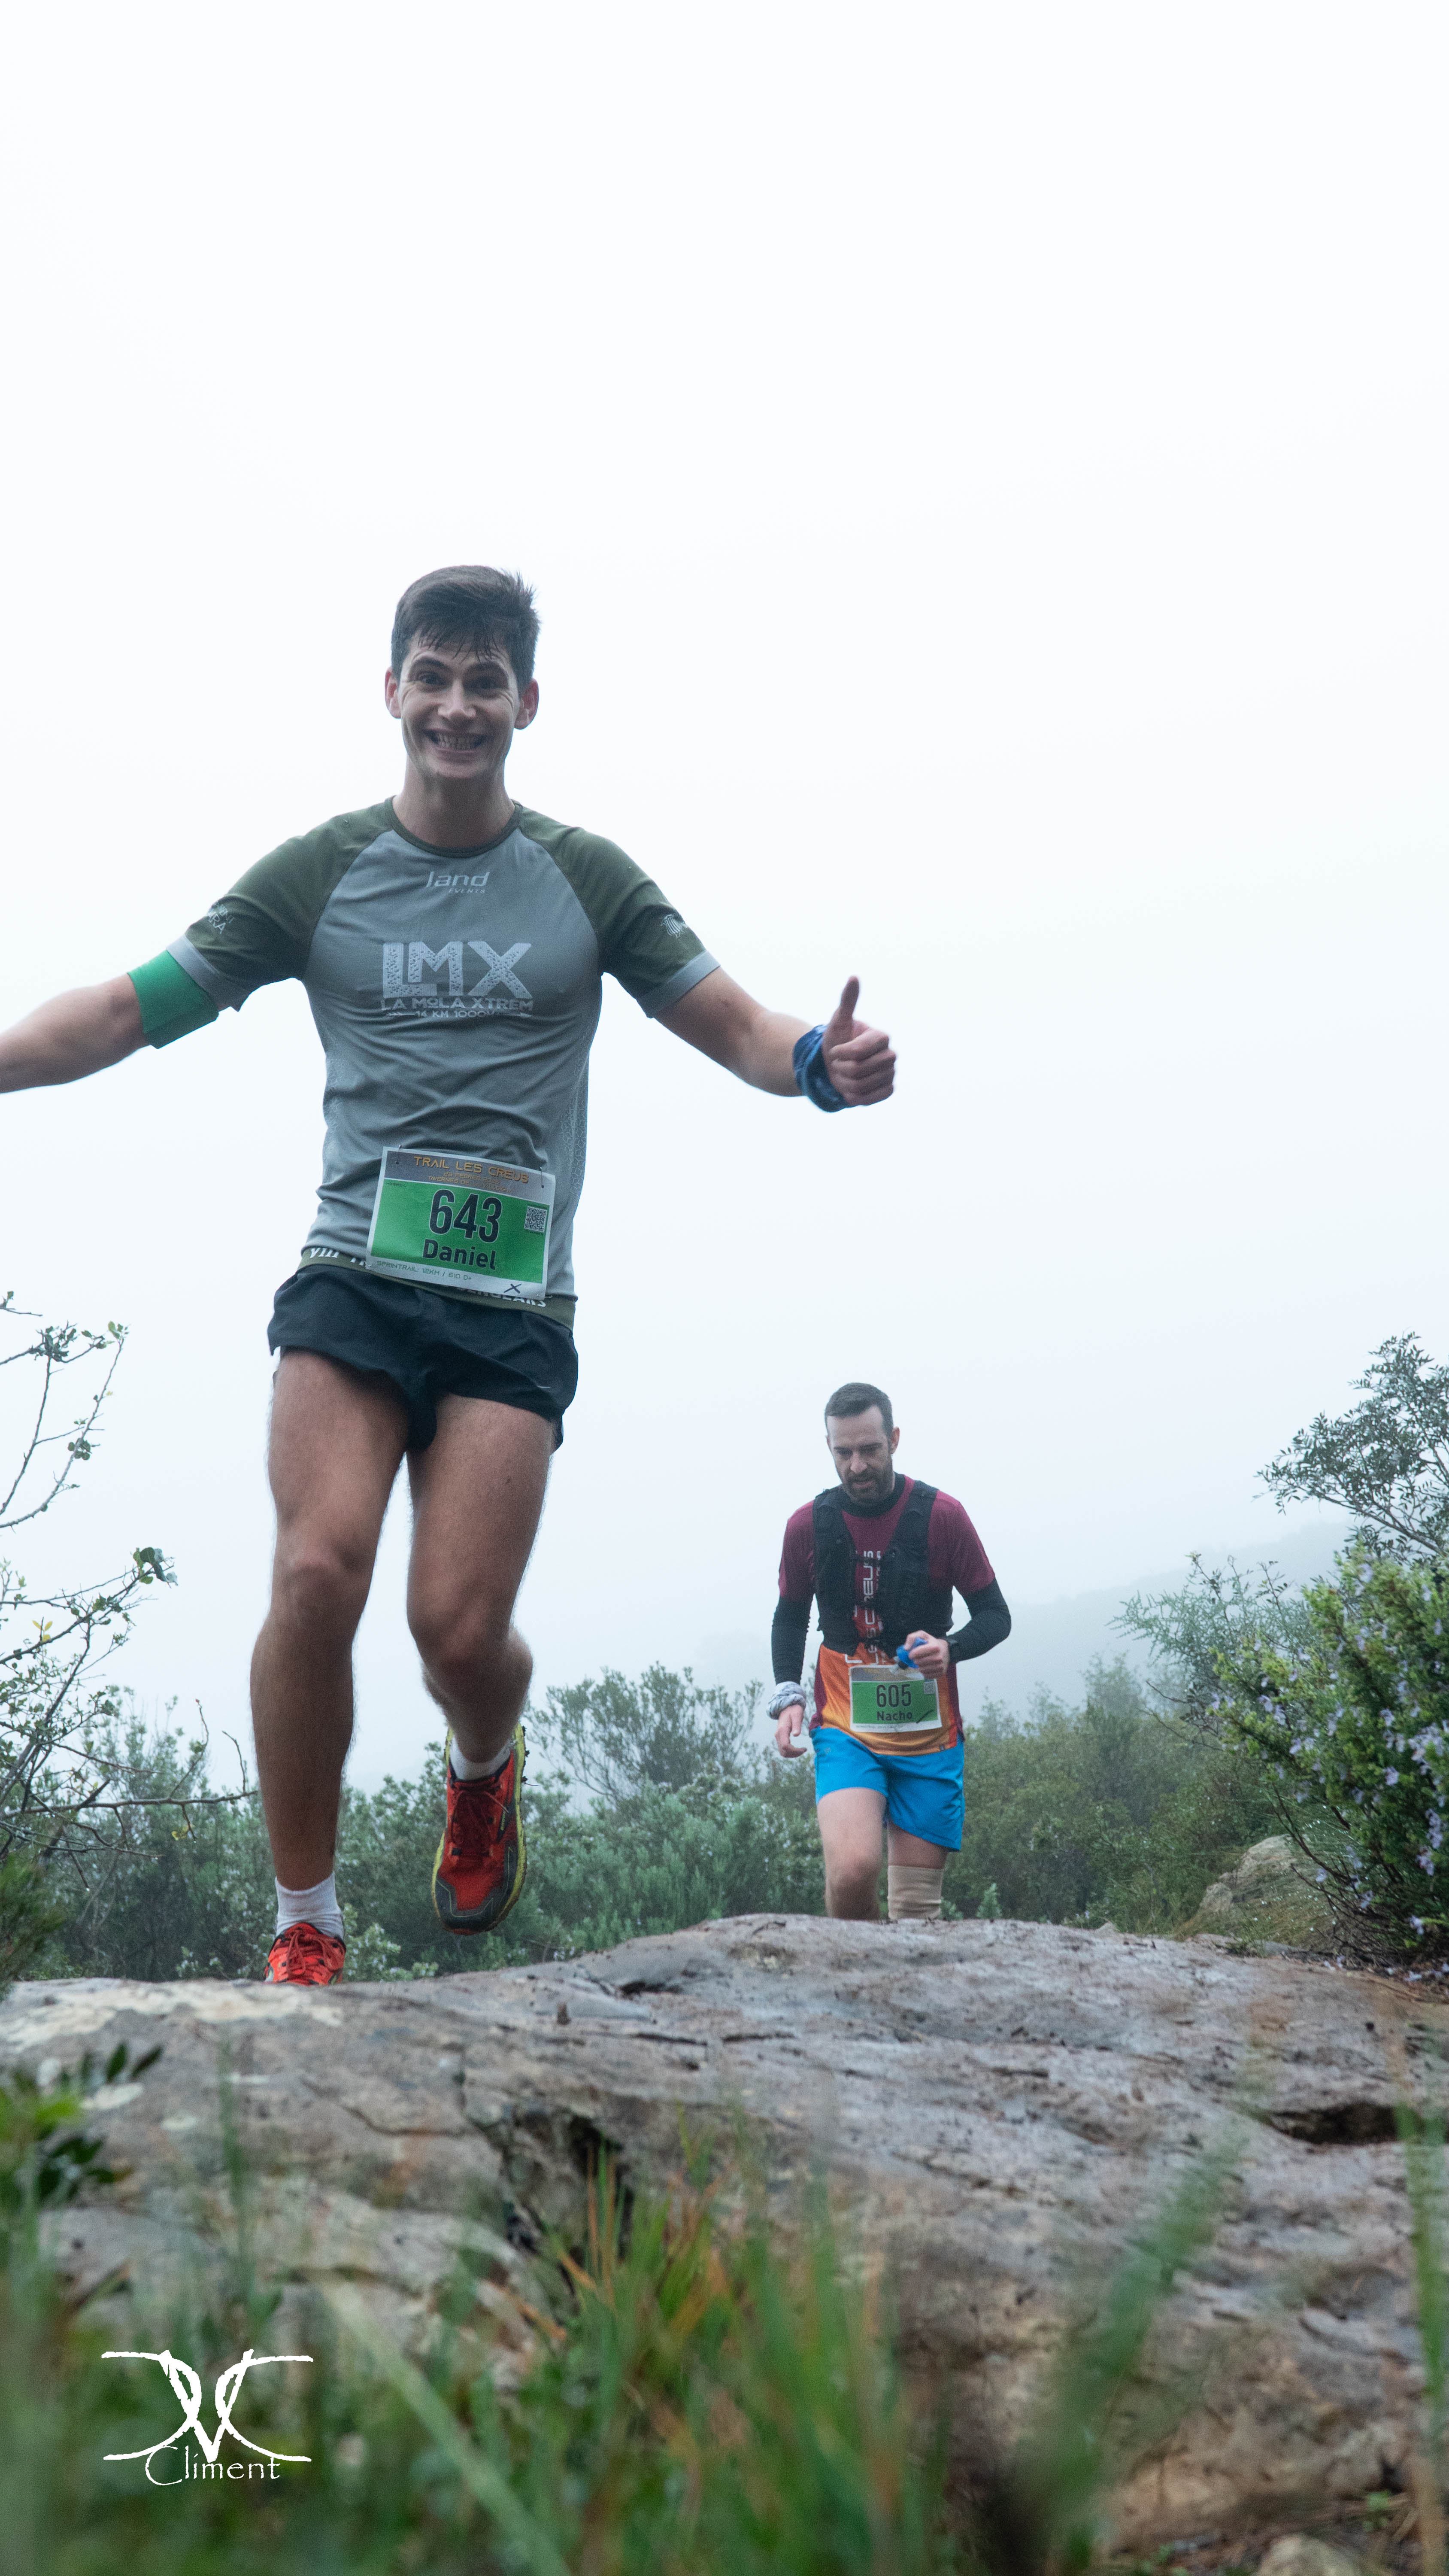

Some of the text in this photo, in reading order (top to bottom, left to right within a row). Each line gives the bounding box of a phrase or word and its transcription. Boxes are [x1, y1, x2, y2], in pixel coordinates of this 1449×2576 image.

[426, 871, 490, 887] land
[382, 941, 532, 999] LMX
[381, 997, 533, 1011] LA MOLA XTREM
[414, 1155, 529, 1183] TRAIL LES CREUS
[429, 1189, 503, 1243] 643
[422, 1239, 496, 1270] Daniel
[876, 1684, 911, 1708] 605
[876, 1710, 912, 1721] Nacho
